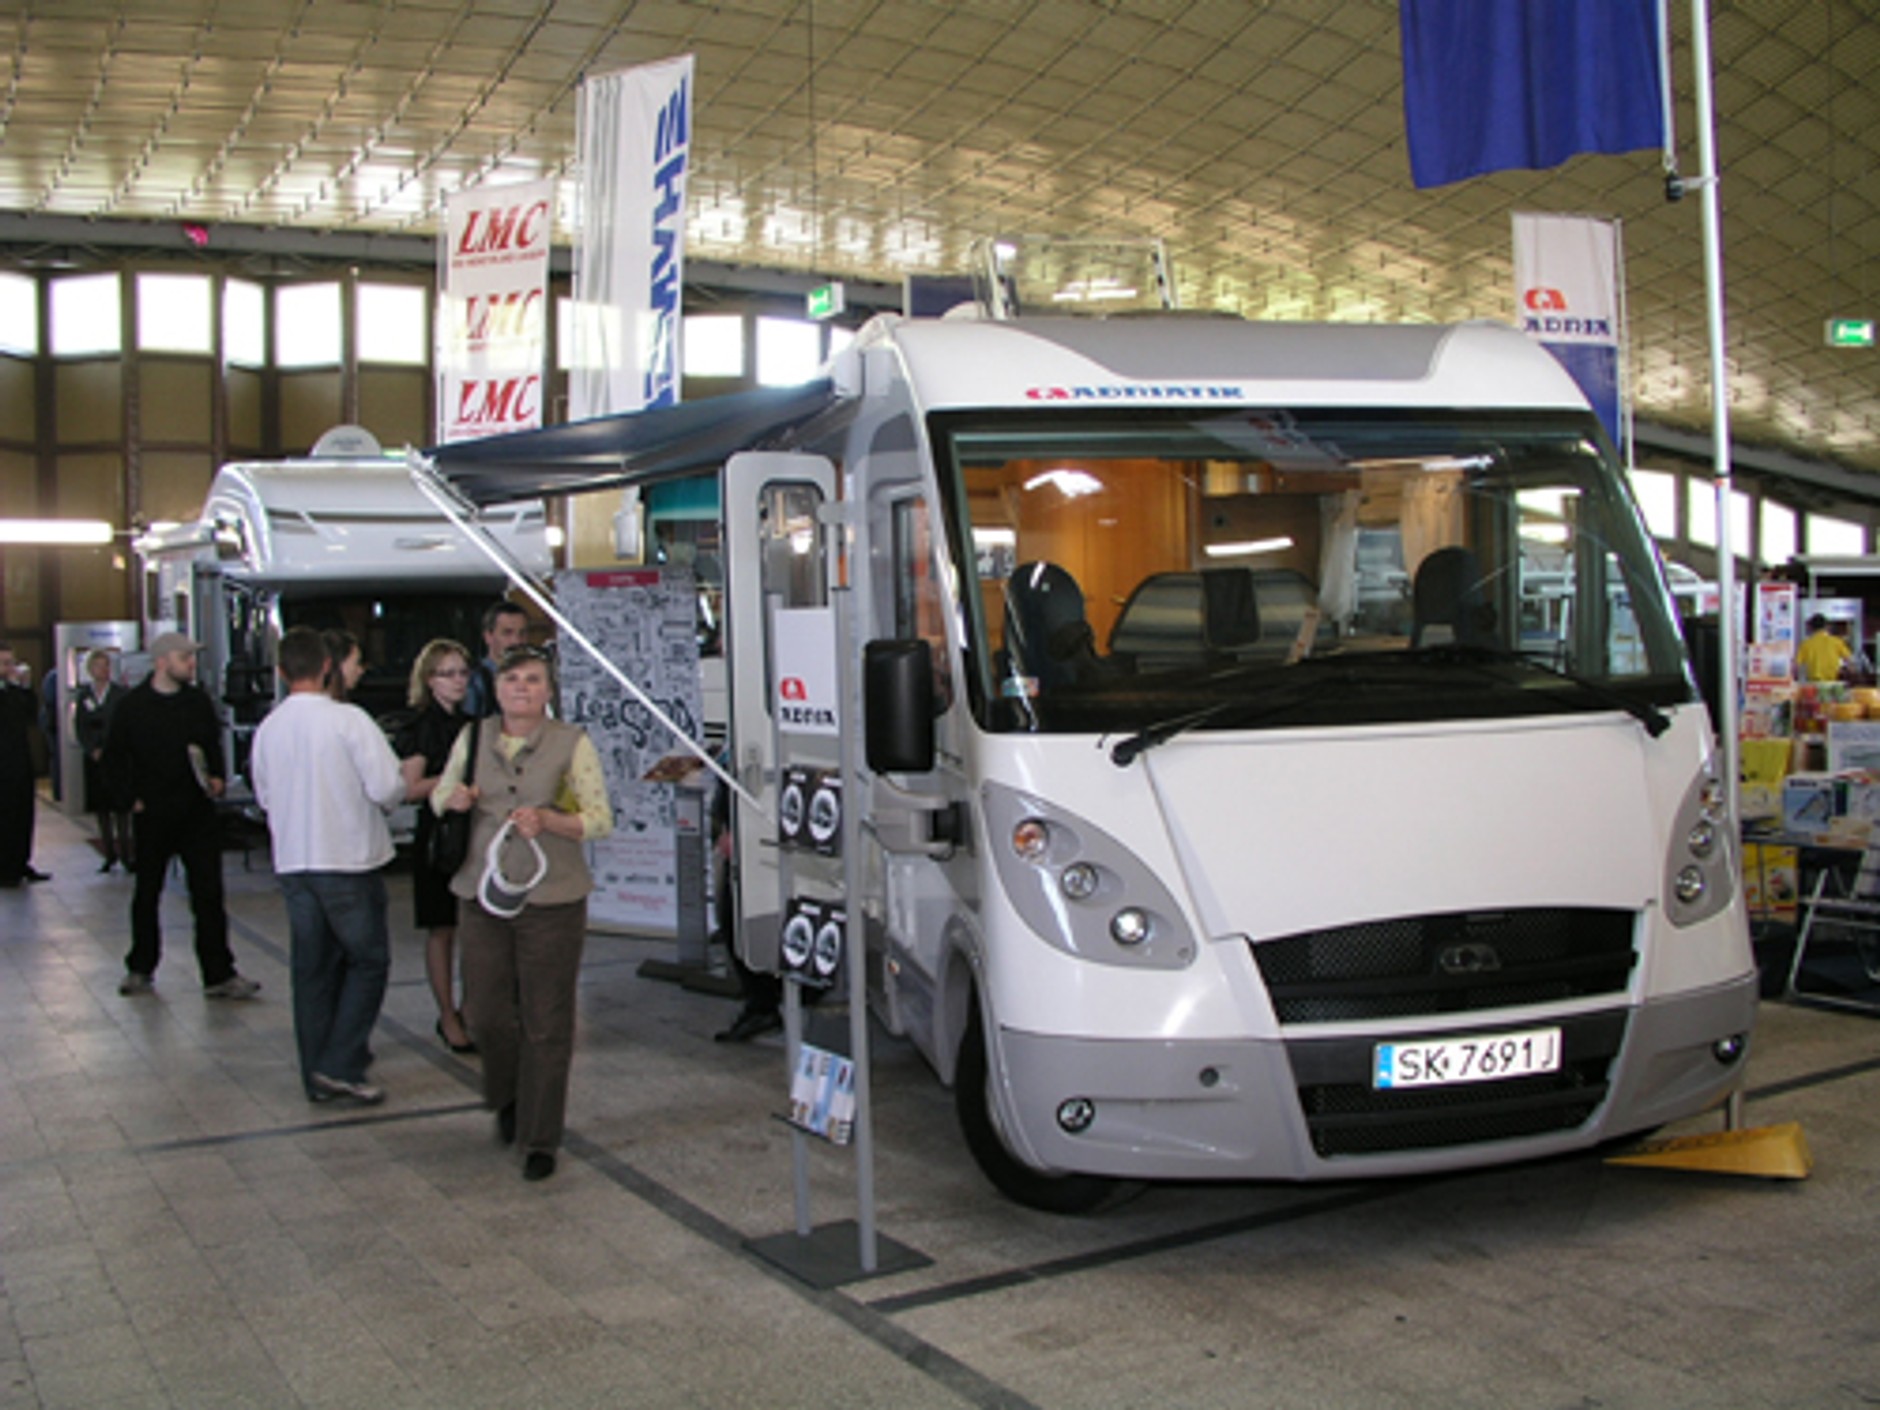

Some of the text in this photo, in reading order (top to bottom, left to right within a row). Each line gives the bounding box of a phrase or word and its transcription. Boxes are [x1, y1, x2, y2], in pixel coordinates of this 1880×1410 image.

[455, 201, 549, 256] LMC
[453, 374, 540, 425] LMC
[1399, 1033, 1555, 1081] SK 7691J
